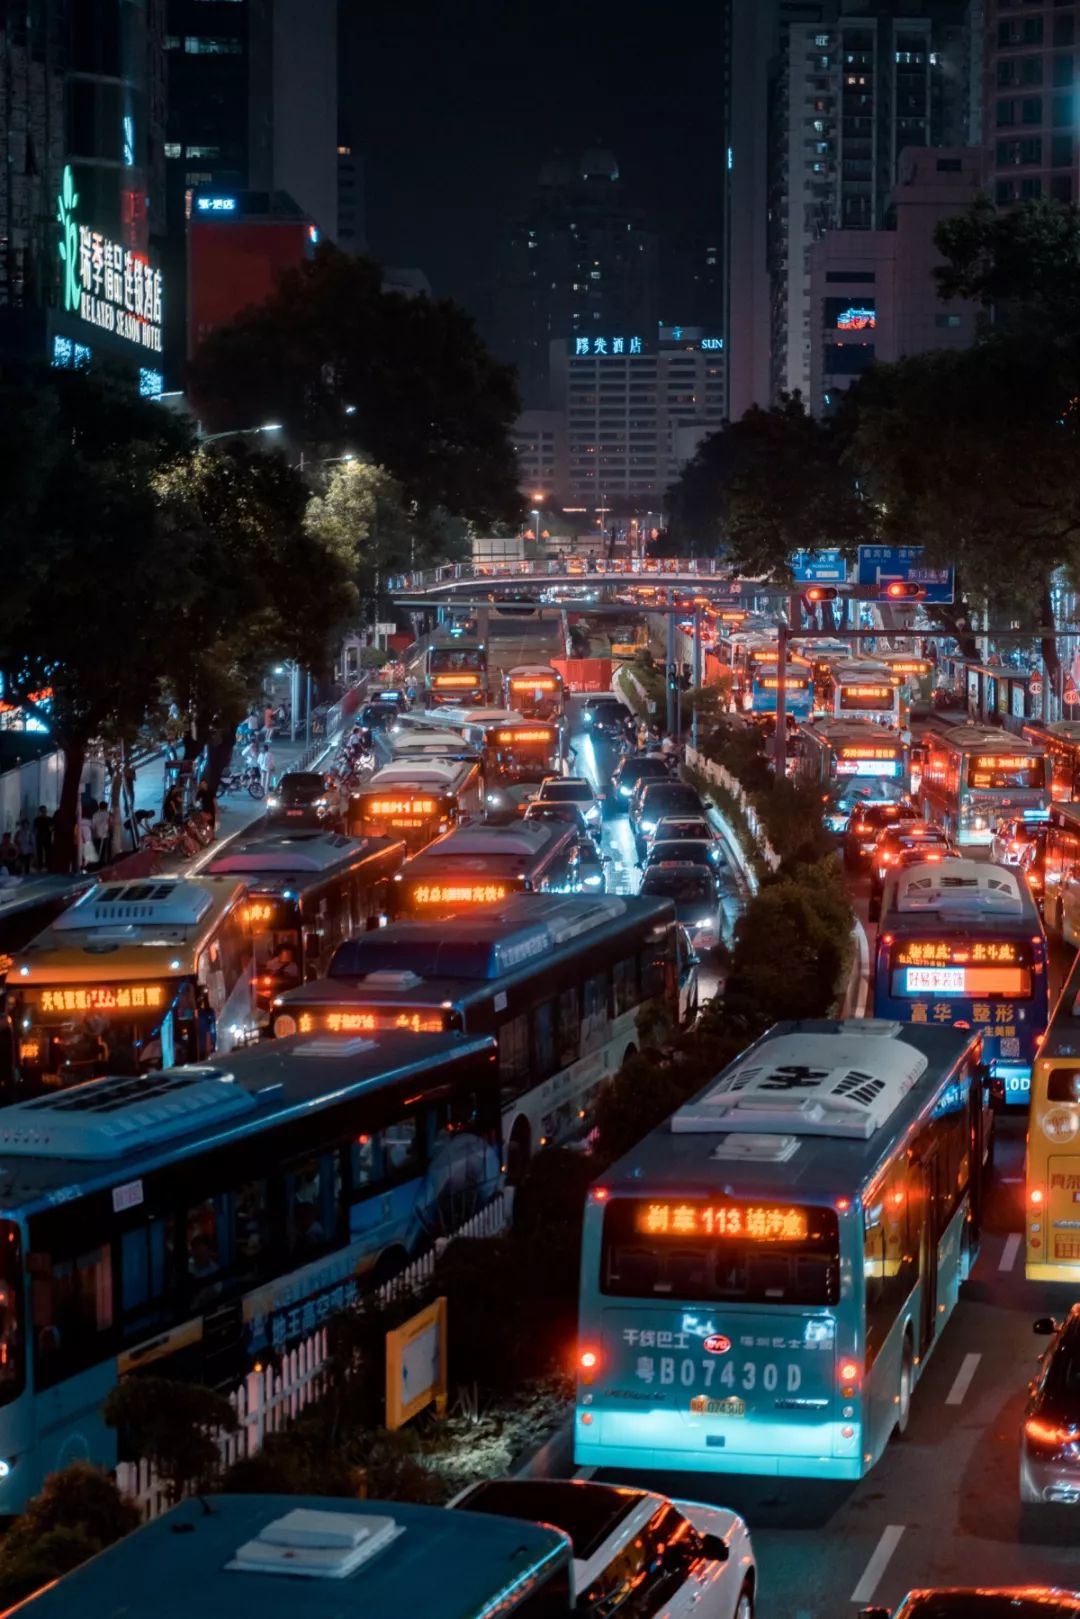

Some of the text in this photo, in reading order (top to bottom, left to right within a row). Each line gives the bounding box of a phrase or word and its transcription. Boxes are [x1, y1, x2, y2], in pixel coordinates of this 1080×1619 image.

[81, 291, 162, 352] RELAXED SEASON HOTEL
[701, 339, 724, 349] SUN
[702, 1206, 741, 1233] 113
